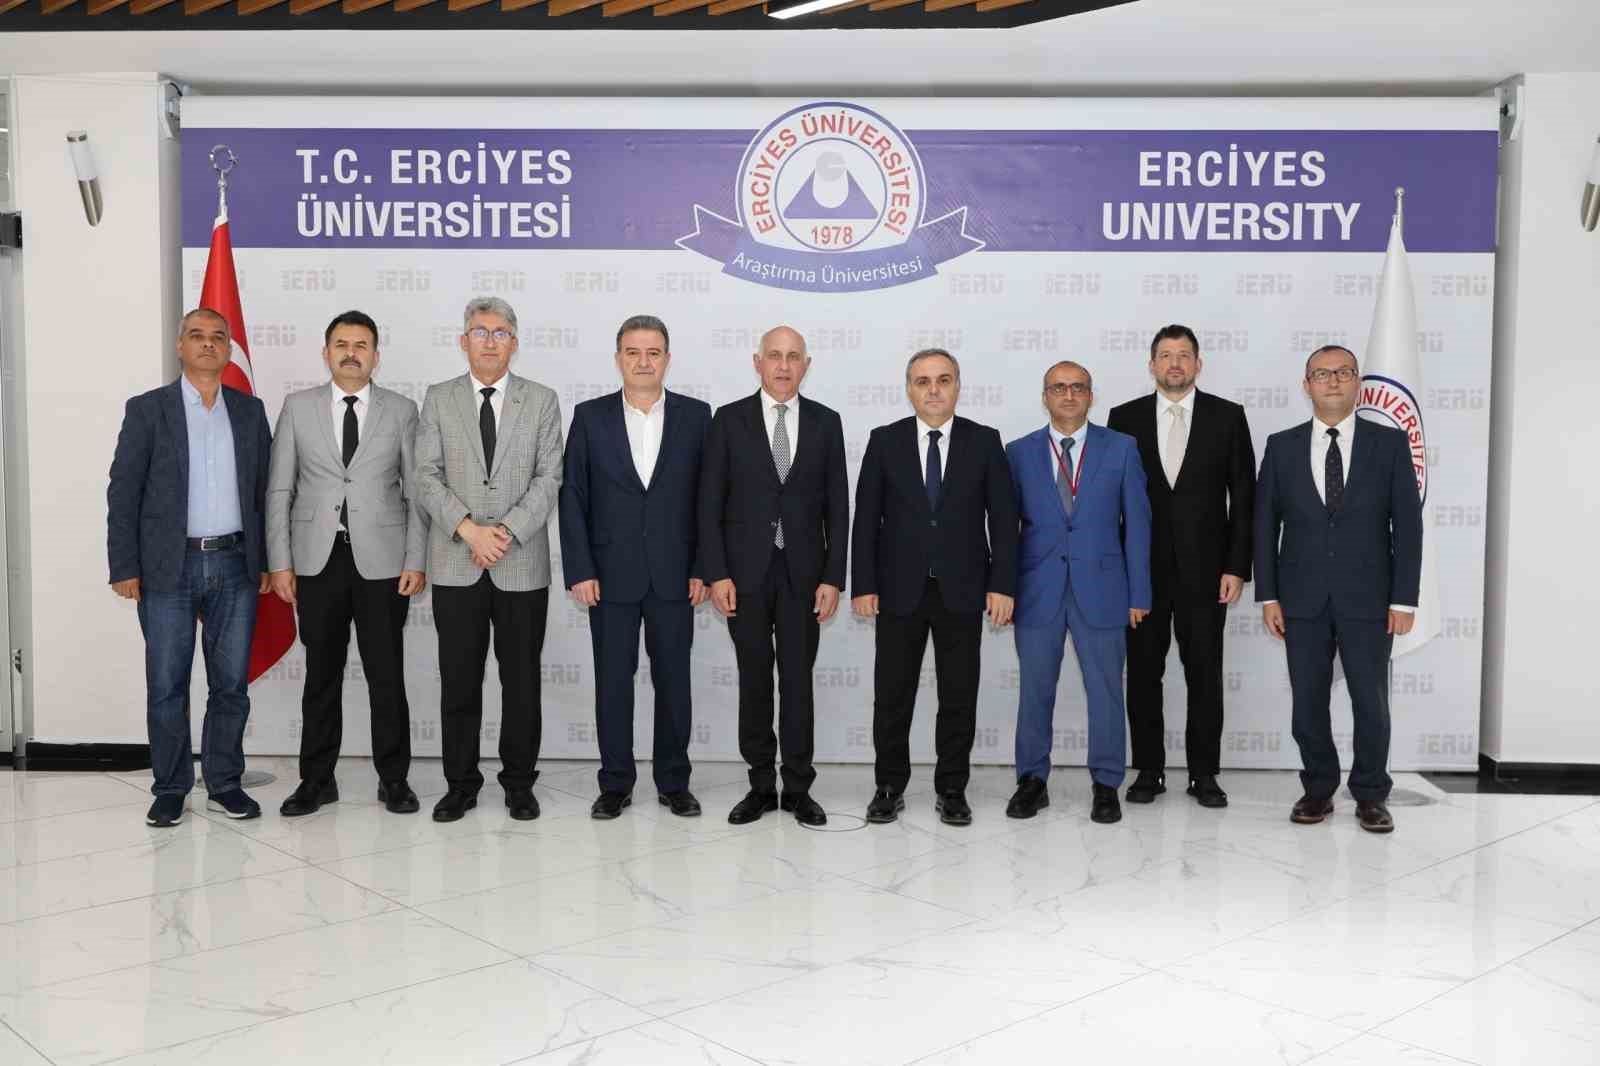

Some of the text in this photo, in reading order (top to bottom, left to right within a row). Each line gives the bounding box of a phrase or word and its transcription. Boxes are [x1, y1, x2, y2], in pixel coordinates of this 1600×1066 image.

[296, 142, 571, 184] T.C. ERCİYES
[751, 110, 911, 236] ERCİYES ÜNİVERSİTESİ
[1139, 144, 1326, 187] ERCİYES
[297, 194, 571, 238] ÜNİVERSİTESİ
[811, 226, 853, 244] 1978
[1102, 202, 1361, 241] UNIVERSITY
[733, 252, 922, 284] Araştırma Üniversitesi
